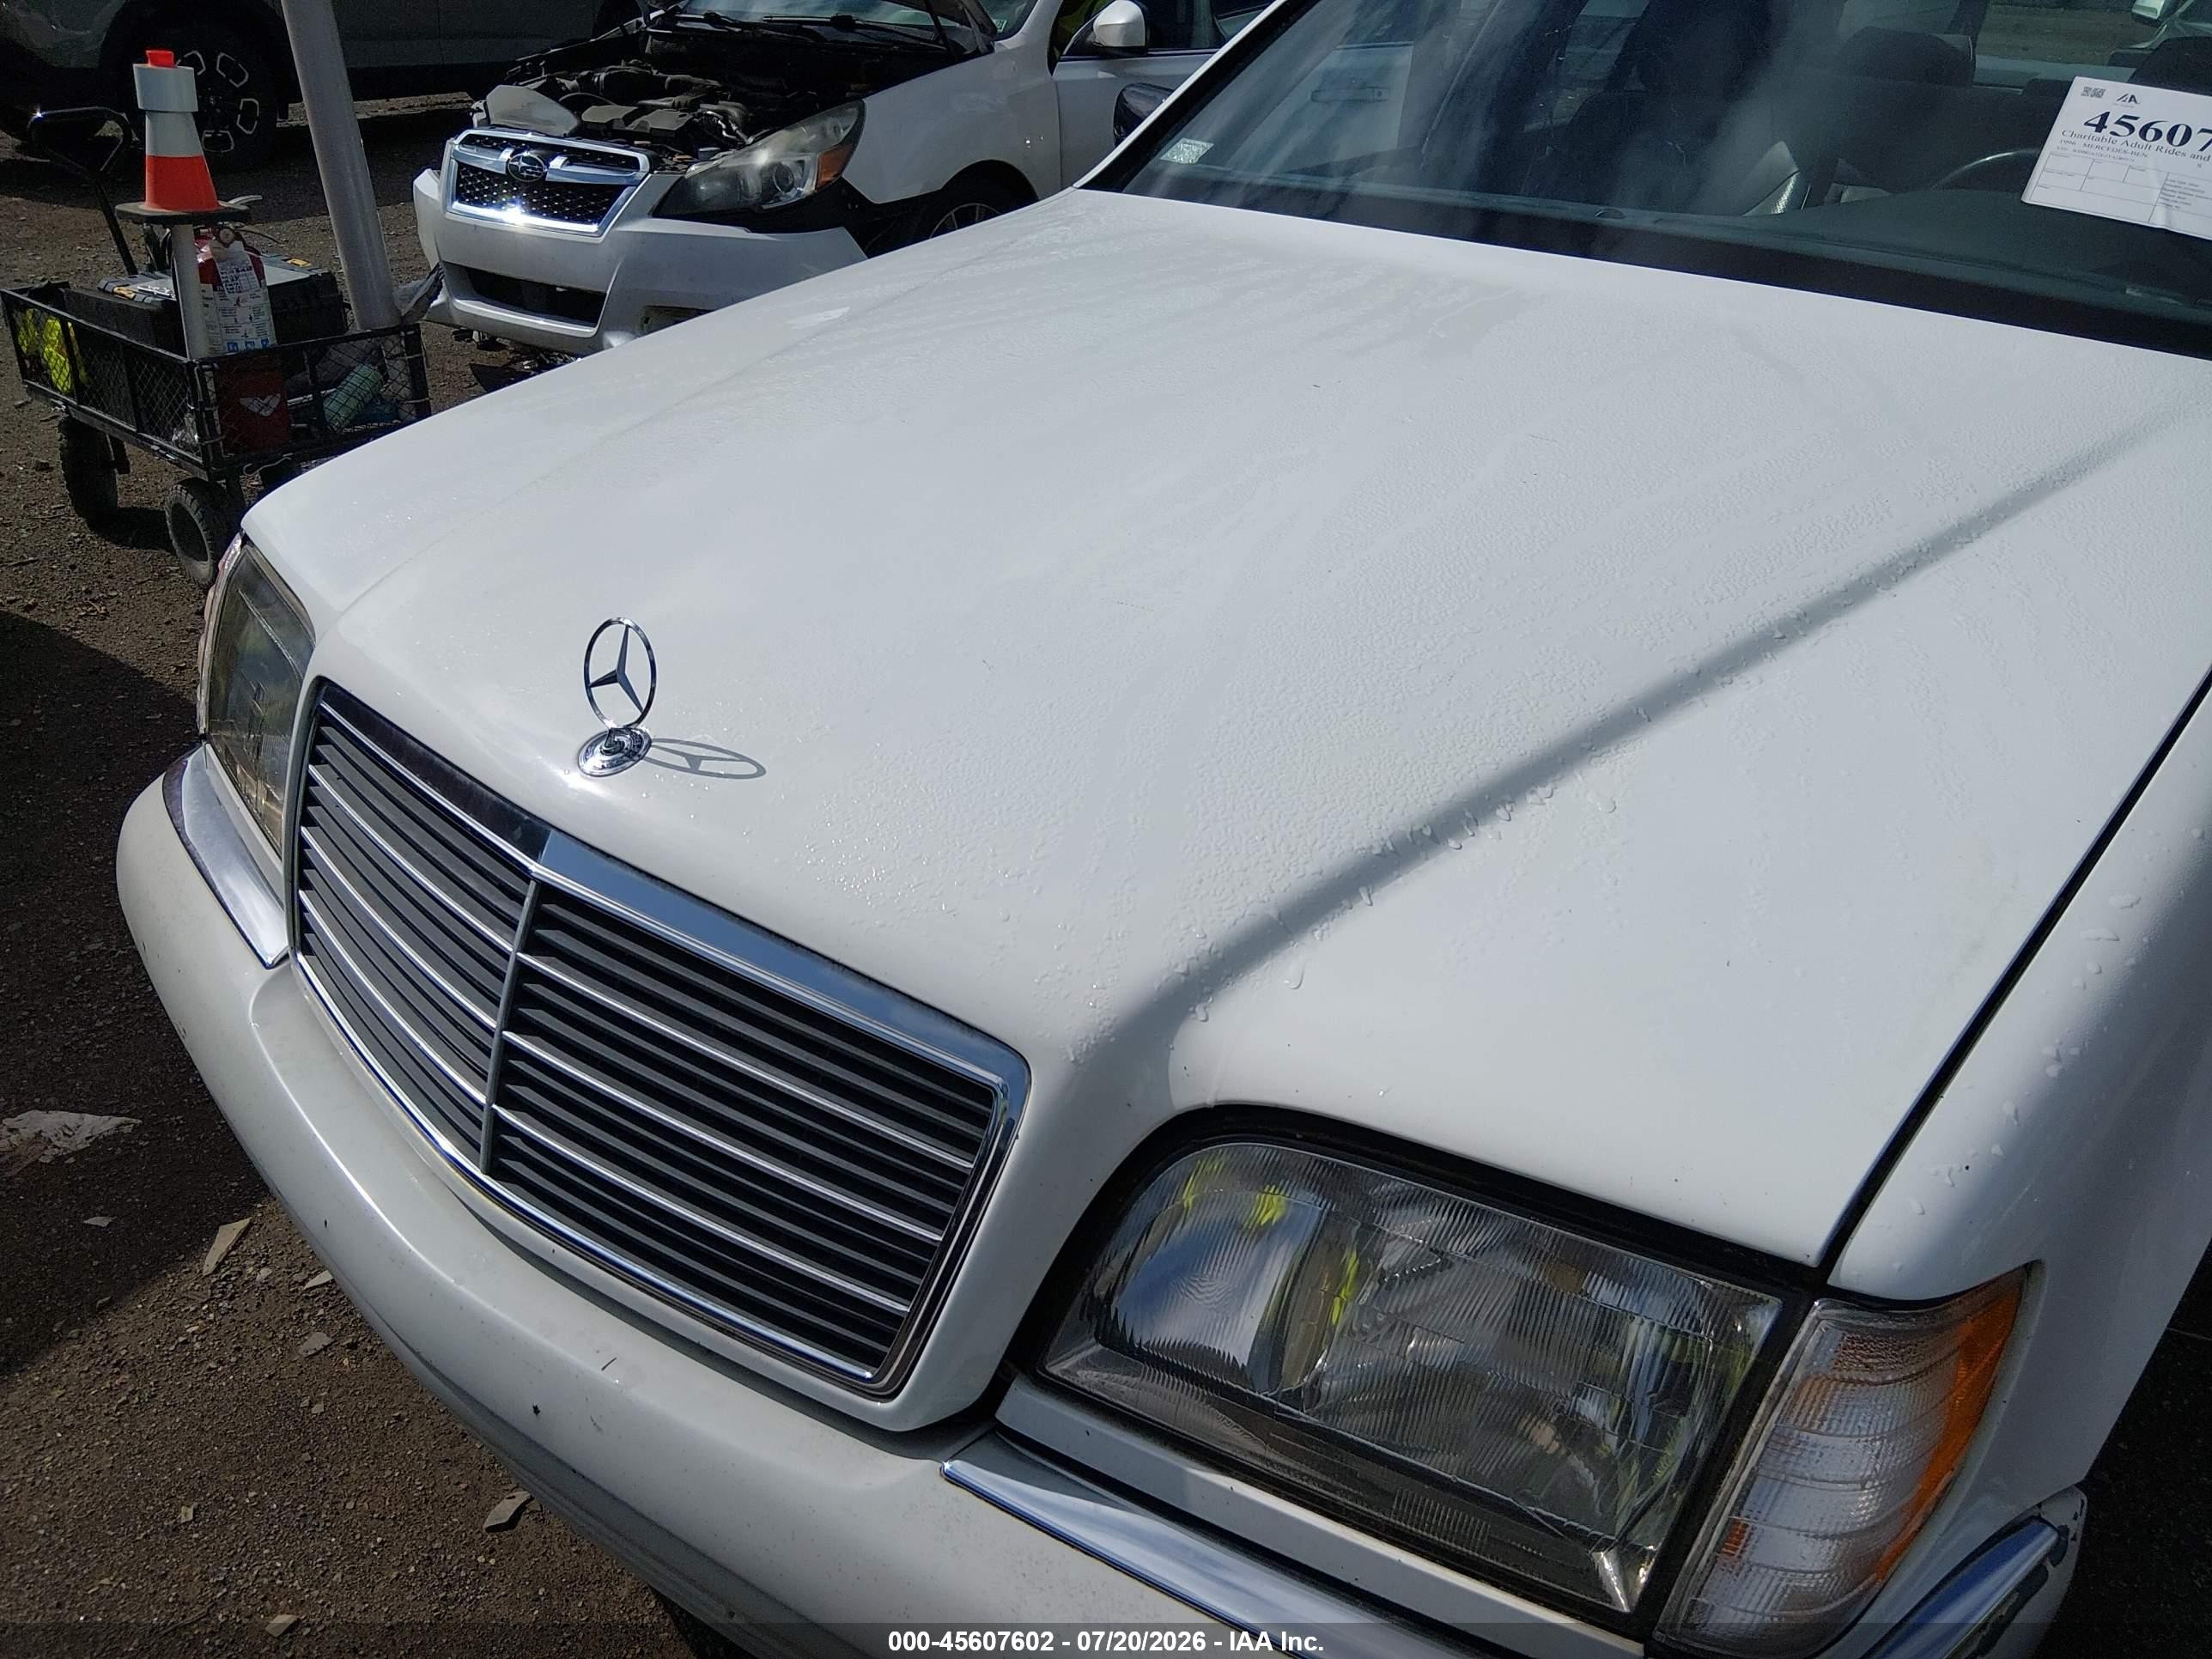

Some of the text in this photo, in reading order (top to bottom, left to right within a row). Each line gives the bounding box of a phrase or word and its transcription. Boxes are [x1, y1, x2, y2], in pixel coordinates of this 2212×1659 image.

[2061, 130, 2212, 162] Charitable Adult Rides and
[2083, 111, 2212, 152] 45607
